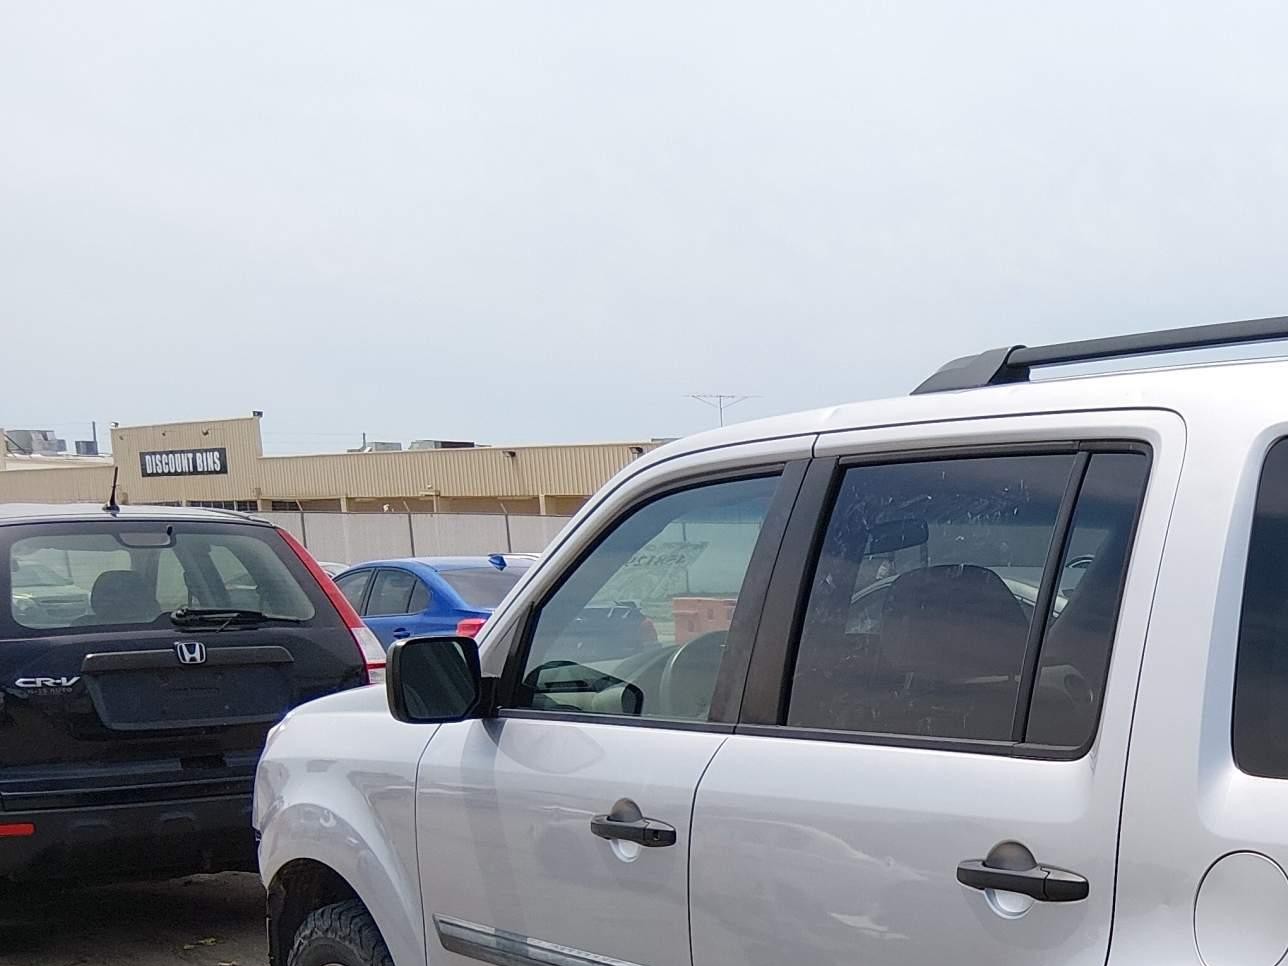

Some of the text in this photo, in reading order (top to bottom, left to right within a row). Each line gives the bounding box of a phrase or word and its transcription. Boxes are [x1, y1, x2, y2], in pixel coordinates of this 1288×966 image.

[145, 451, 221, 474] DISCOUNT BINS
[15, 676, 80, 688] CR-V
